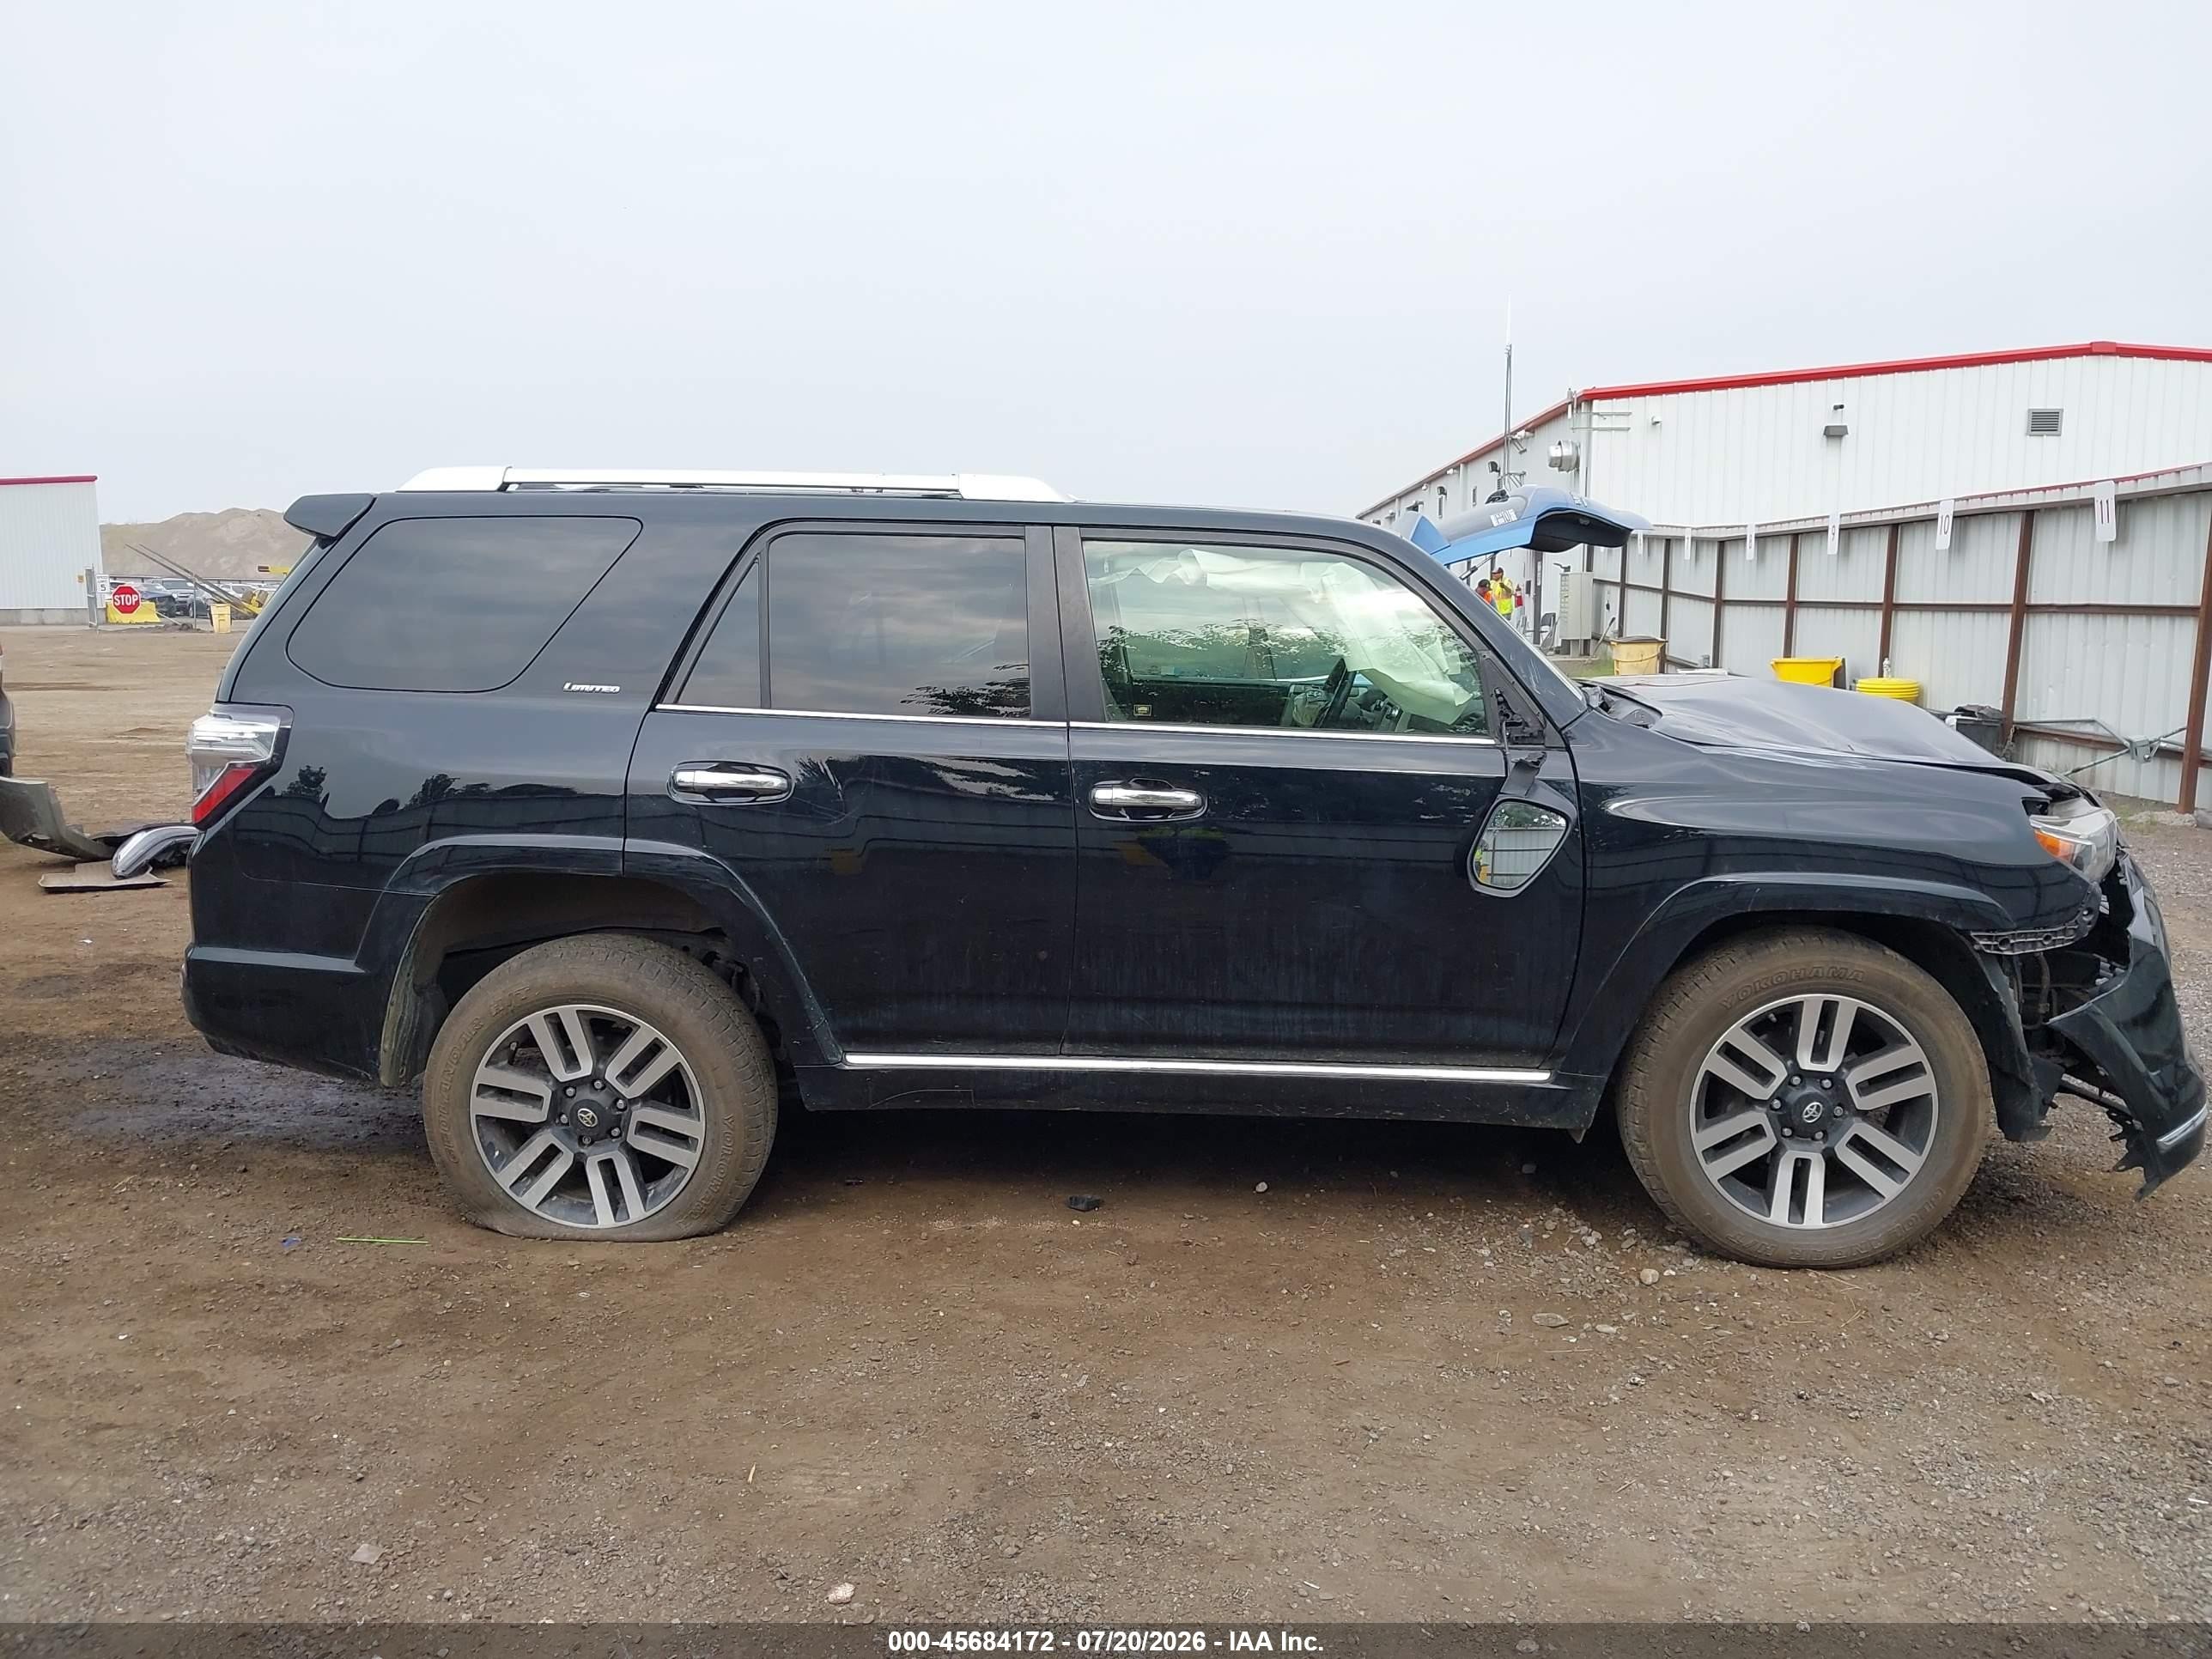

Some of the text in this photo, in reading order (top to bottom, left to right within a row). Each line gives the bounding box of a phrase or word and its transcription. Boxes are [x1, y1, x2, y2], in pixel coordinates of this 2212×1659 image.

[2100, 499, 2110, 524] 11
[1831, 525, 1836, 542] 9
[1940, 514, 1949, 535] 10
[113, 594, 138, 606] STOP
[1719, 965, 1866, 1011] YOKOHAMA
